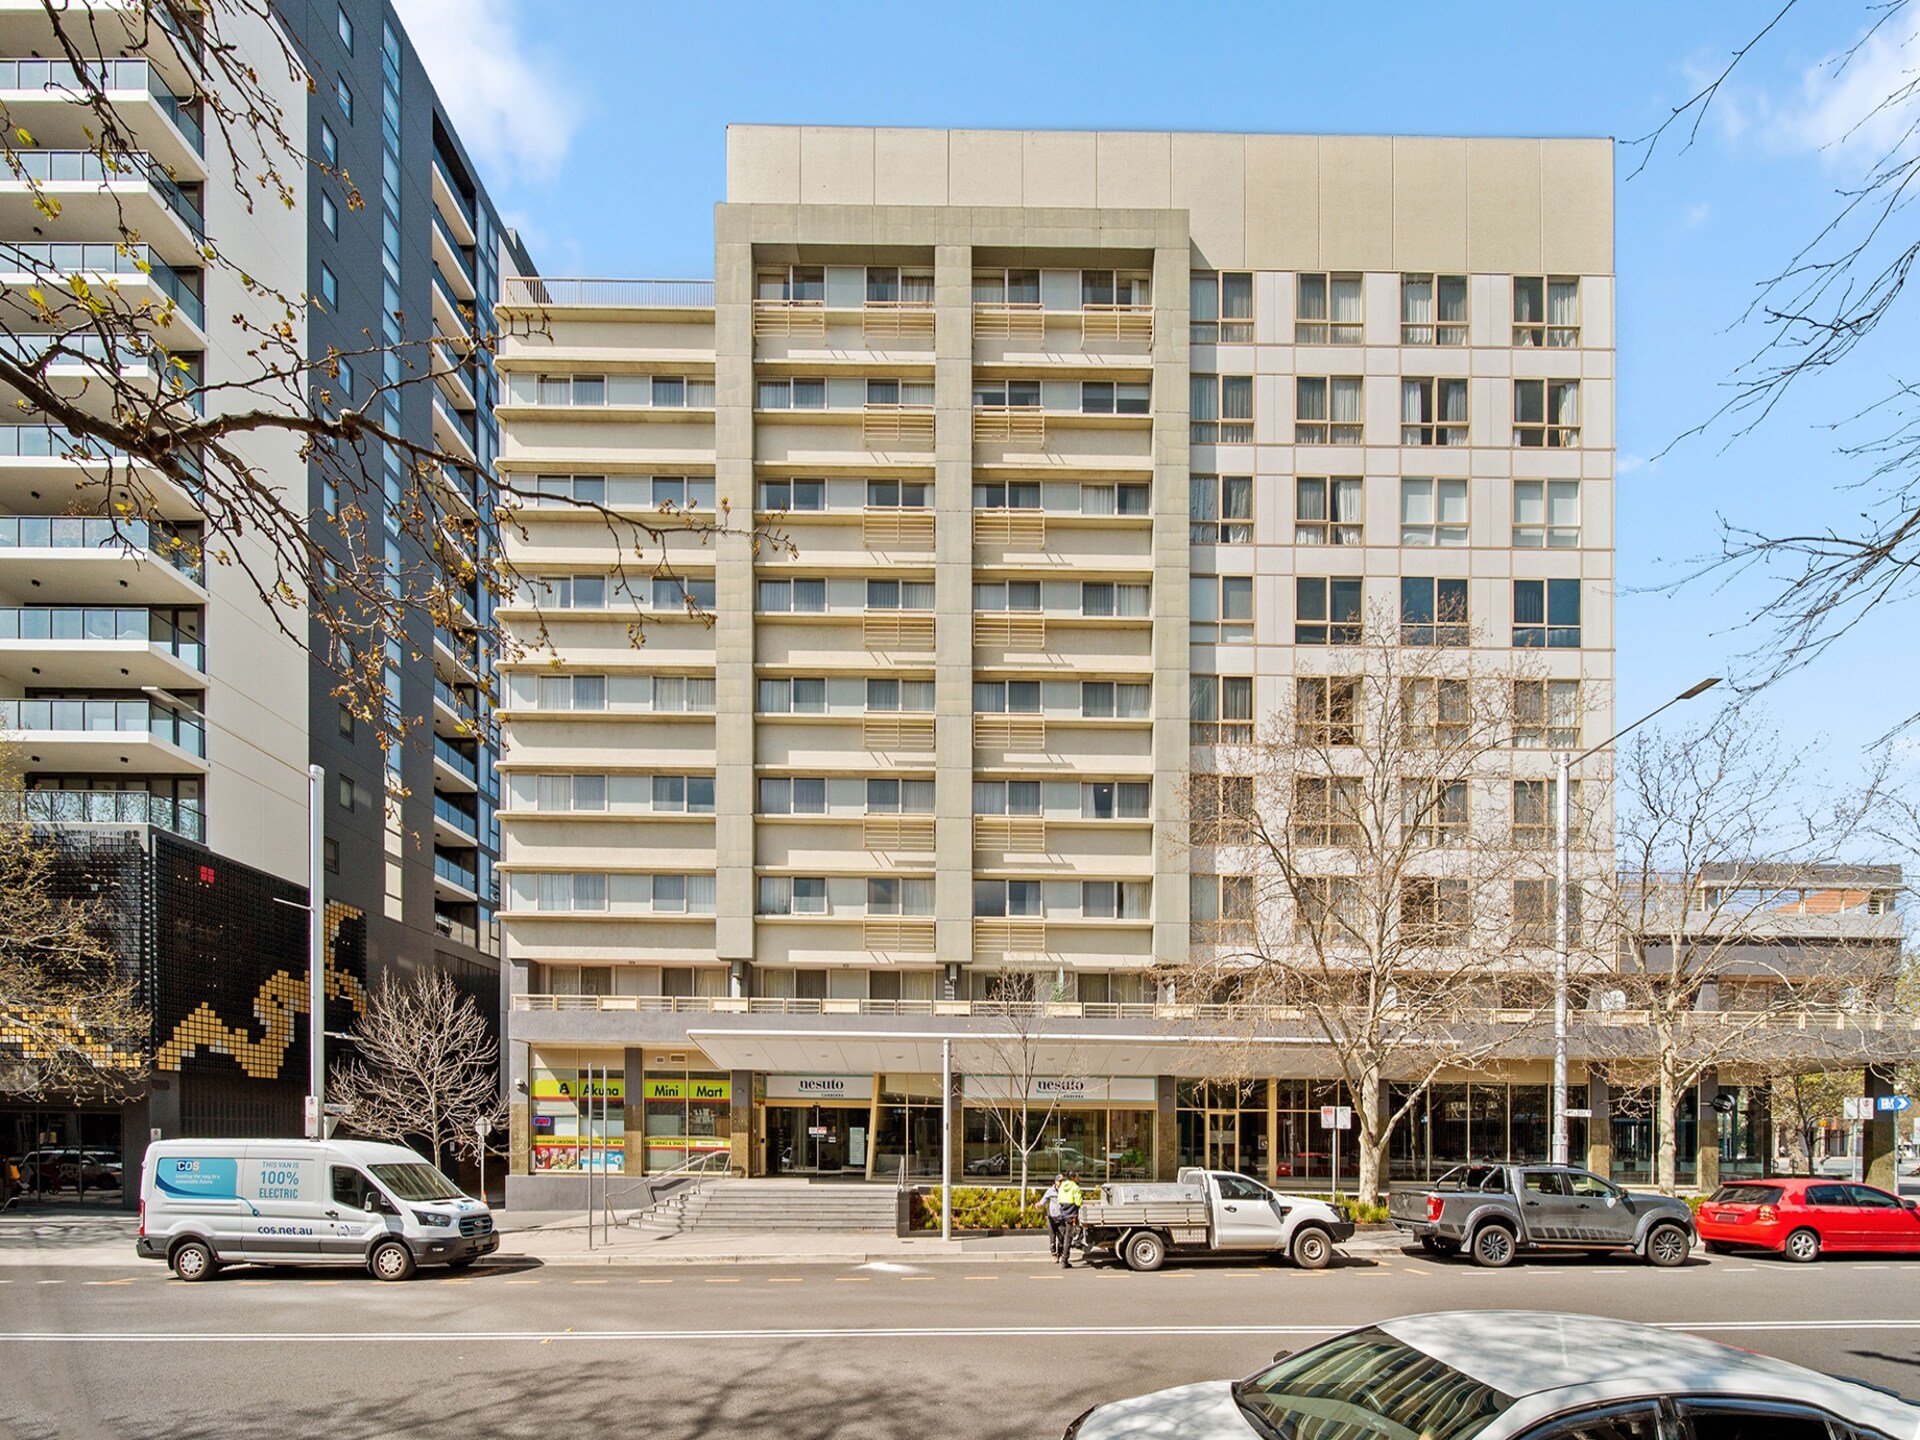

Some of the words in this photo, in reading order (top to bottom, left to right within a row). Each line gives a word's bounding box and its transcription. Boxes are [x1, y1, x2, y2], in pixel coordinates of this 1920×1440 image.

[583, 1082, 619, 1096] Akuna
[654, 1085, 679, 1097] Mini
[696, 1085, 723, 1097] Mart
[800, 1079, 844, 1090] nesuto
[1038, 1079, 1084, 1091] nesuto
[177, 1161, 200, 1171] COS
[260, 1171, 299, 1185] 100%
[259, 1187, 299, 1199] ELECTRIC
[257, 1226, 313, 1235] cos.net.au
